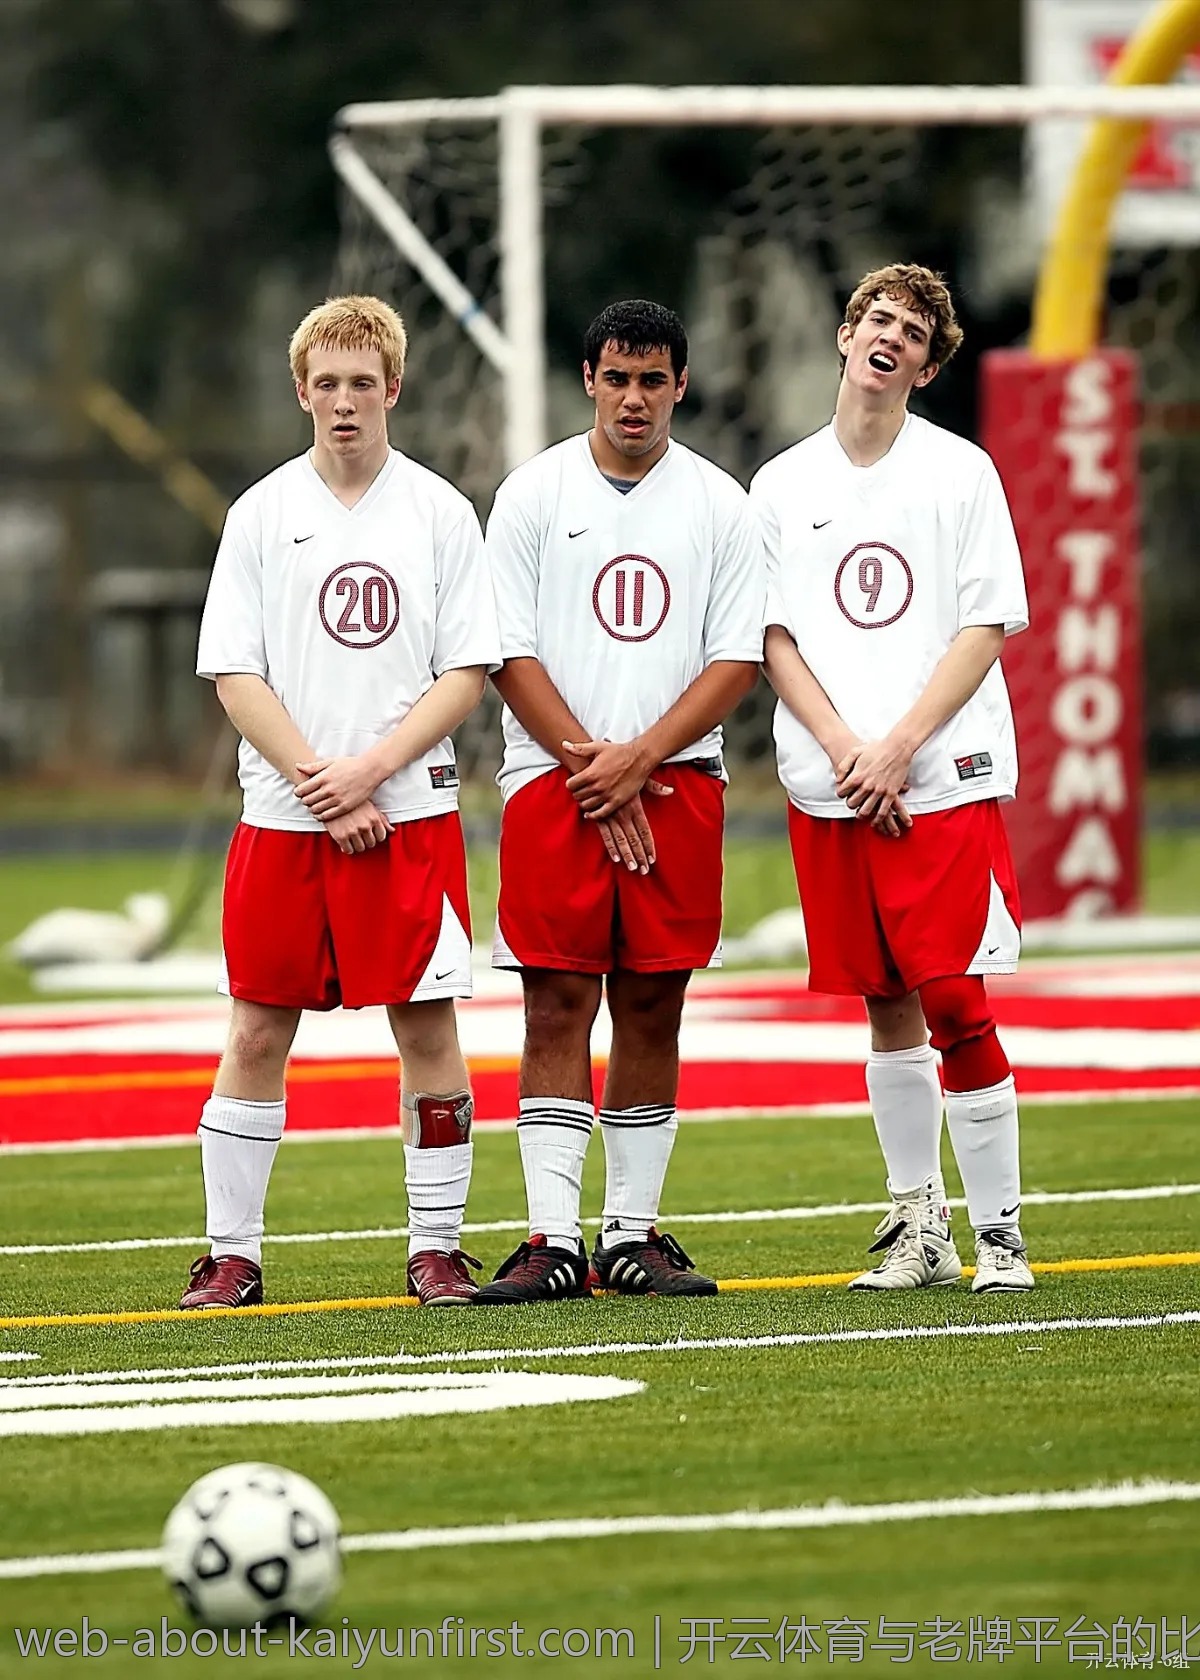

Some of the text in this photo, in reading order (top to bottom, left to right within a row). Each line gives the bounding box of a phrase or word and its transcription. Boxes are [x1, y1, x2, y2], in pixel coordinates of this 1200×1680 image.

[336, 576, 388, 633] 20
[616, 573, 644, 626] 11
[859, 557, 882, 612] 9
